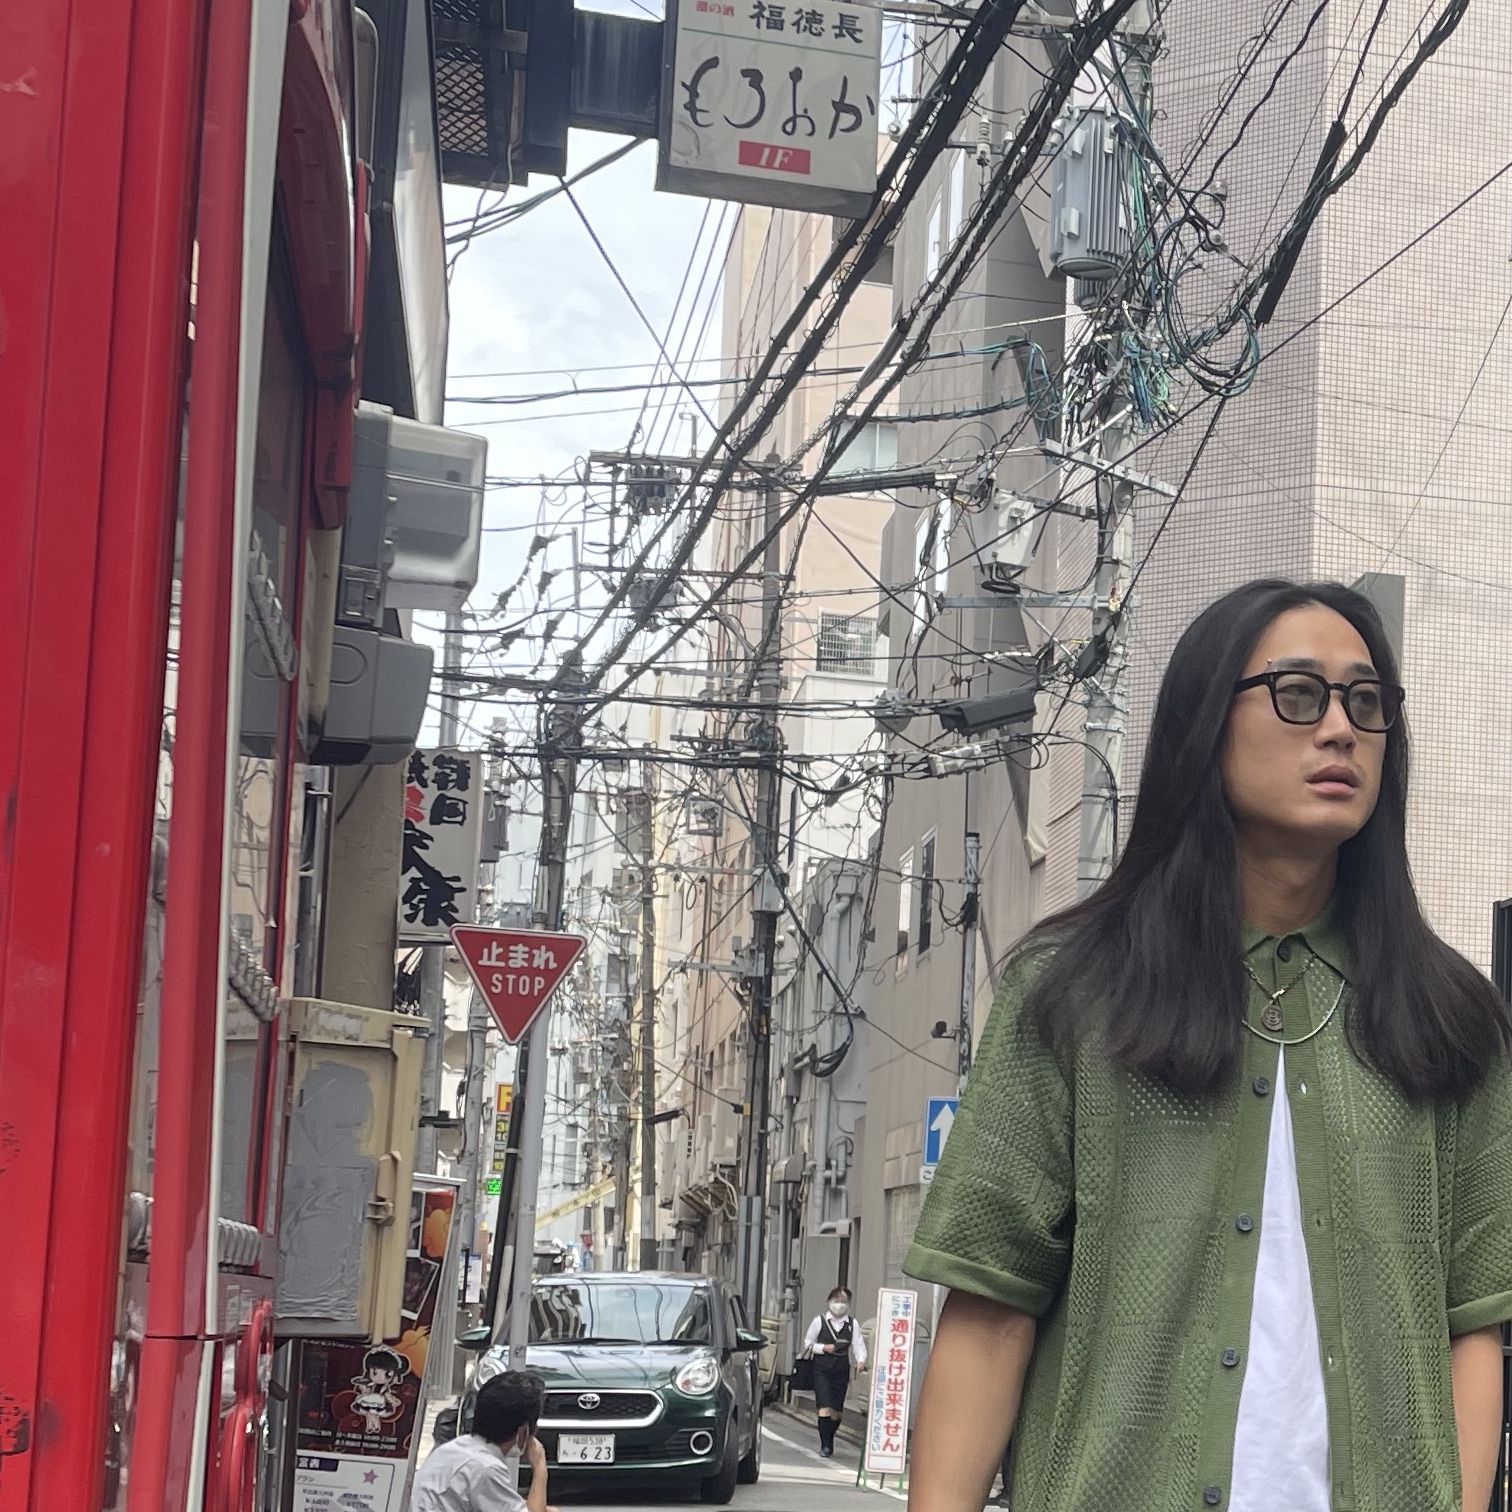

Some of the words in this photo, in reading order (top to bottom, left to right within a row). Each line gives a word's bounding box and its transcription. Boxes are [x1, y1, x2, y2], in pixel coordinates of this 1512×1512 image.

[749, 1, 863, 44] 福徳長
[681, 56, 875, 139] もろおか
[759, 147, 793, 168] 1F
[478, 941, 557, 970] 止まれ
[491, 973, 545, 997] STOP
[883, 1318, 910, 1452] 通り抜け出来ません
